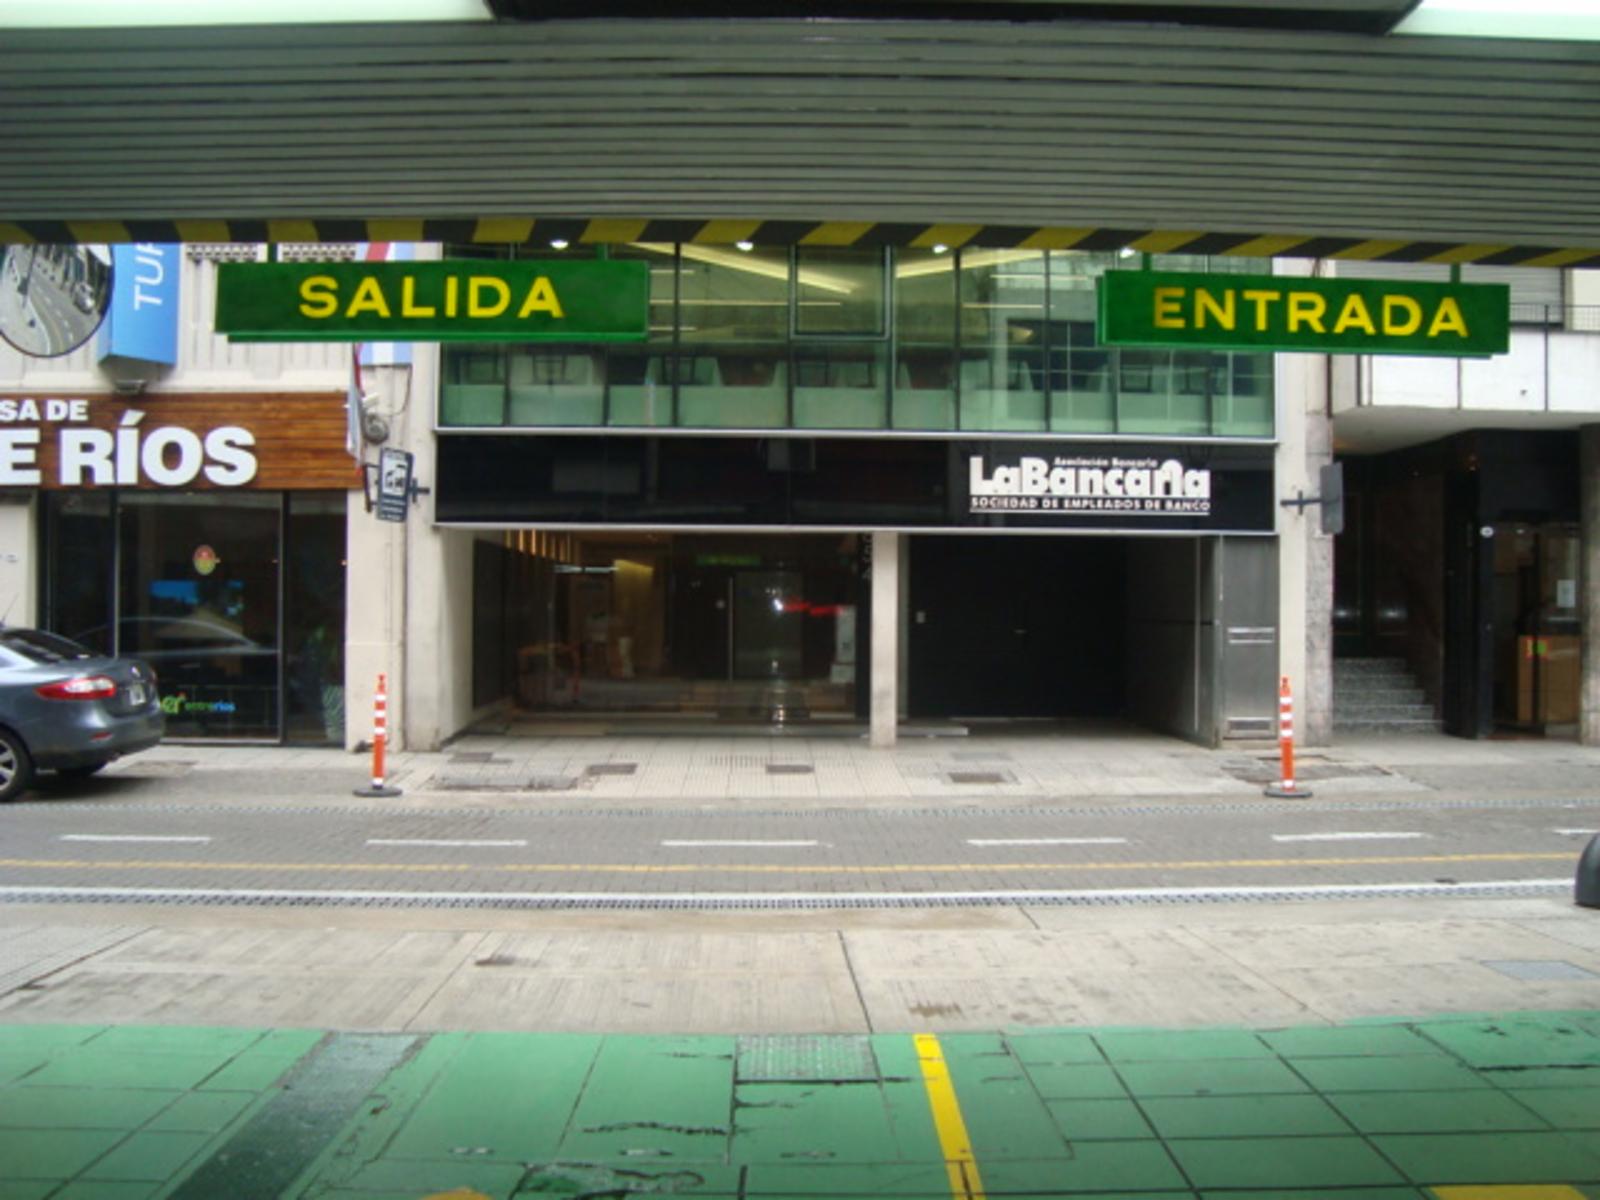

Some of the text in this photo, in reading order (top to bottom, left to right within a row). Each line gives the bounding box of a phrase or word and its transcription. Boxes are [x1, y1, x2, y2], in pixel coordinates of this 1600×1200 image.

[299, 276, 564, 318] SALIDA
[1153, 287, 1469, 337] ENTRADA
[46, 399, 89, 421] DE
[60, 410, 257, 486] RÍOS
[972, 497, 1211, 511] SOCIEDAD DE EMPLEADOS DE BANCO
